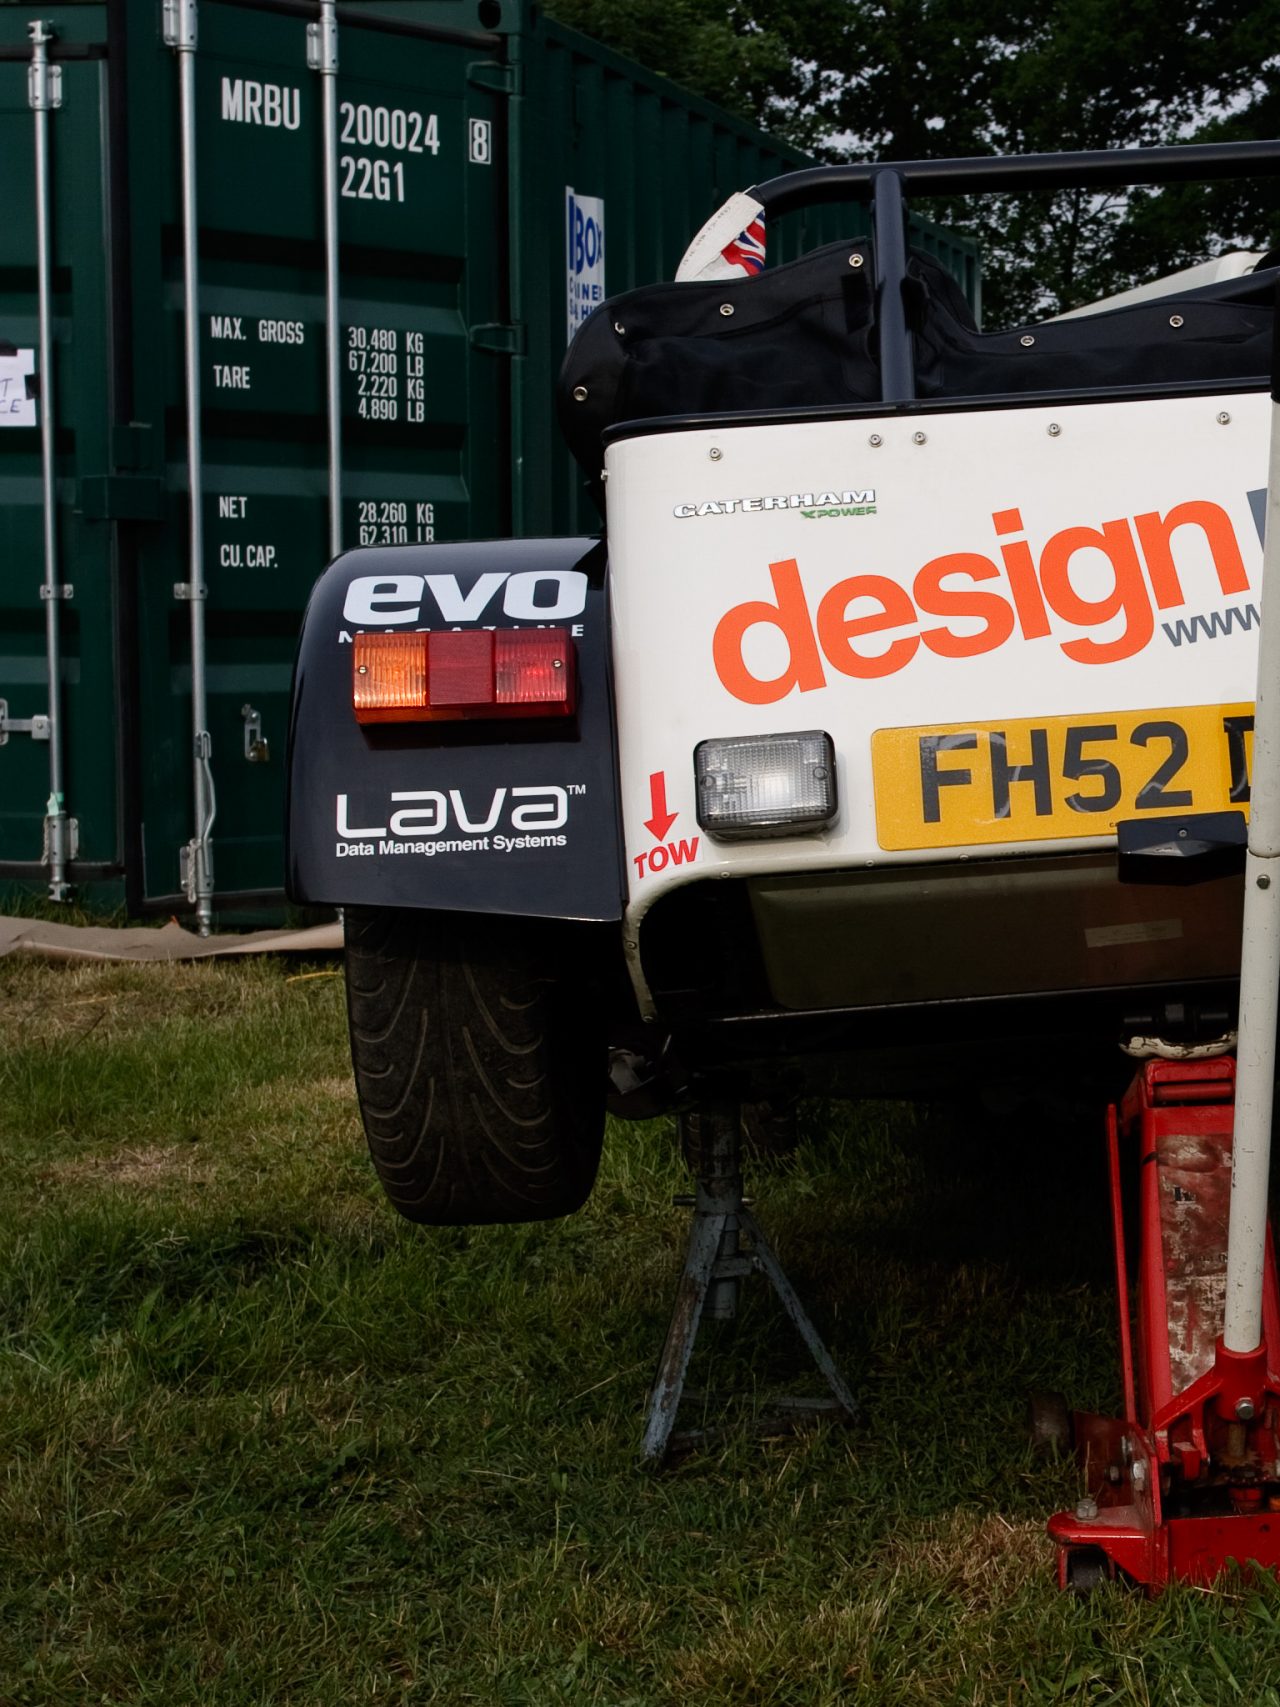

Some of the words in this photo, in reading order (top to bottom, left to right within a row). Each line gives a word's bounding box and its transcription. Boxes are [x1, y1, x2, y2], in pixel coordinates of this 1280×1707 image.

[221, 77, 301, 130] MRBU
[340, 102, 441, 156] 200024
[471, 121, 488, 162] 8
[340, 156, 405, 202] 22G1
[210, 316, 247, 341] MAX.
[258, 319, 304, 345] GROSS
[406, 332, 424, 354] KG
[213, 365, 250, 389] TARE
[407, 378, 425, 400] KG
[406, 355, 424, 377] LB
[358, 397, 398, 421] 4,890
[407, 401, 425, 423] LB
[219, 496, 247, 519] NET
[416, 503, 434, 524] KG
[673, 489, 876, 518] CATERHAM
[343, 570, 588, 625] evo
[918, 721, 1193, 823] FH52
[336, 842, 374, 858] Data
[378, 836, 490, 856] Management
[493, 834, 568, 850] Systems
[633, 837, 700, 879] TOW
